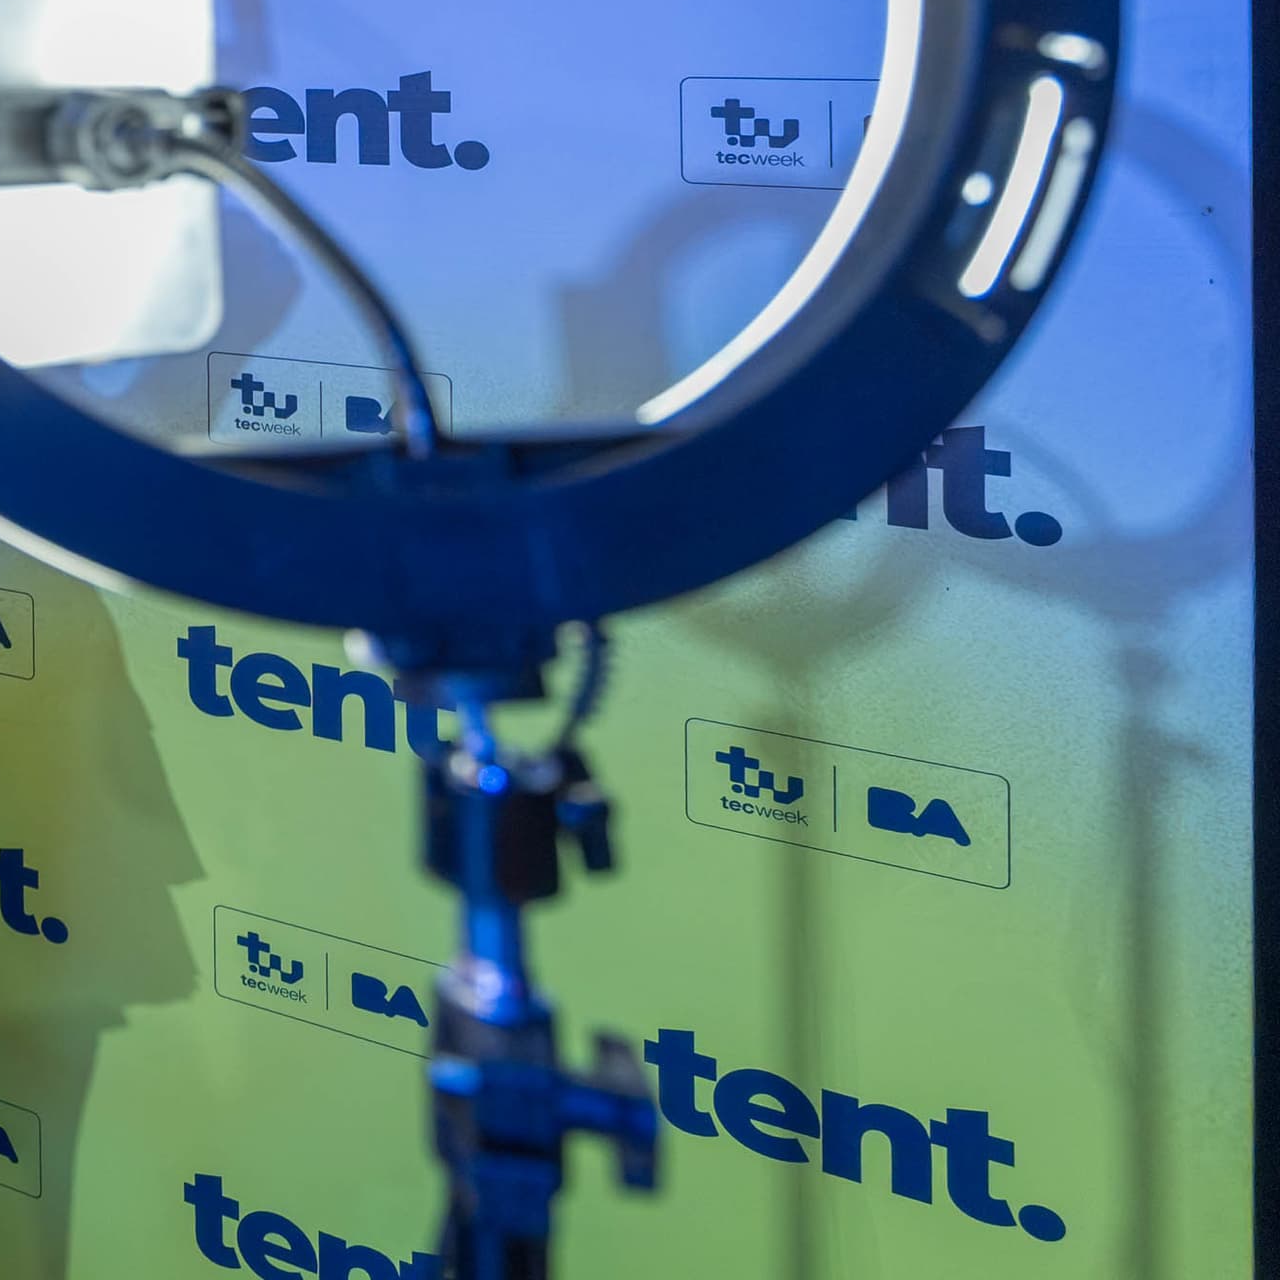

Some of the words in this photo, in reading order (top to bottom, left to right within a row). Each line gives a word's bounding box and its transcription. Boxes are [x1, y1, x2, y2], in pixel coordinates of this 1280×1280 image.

[241, 70, 490, 171] ent.
[715, 151, 805, 167] tecweek
[235, 418, 302, 437] tecweek
[720, 795, 809, 827] tecweek
[241, 974, 308, 1004] tecweek
[644, 1028, 1066, 1242] tent.
